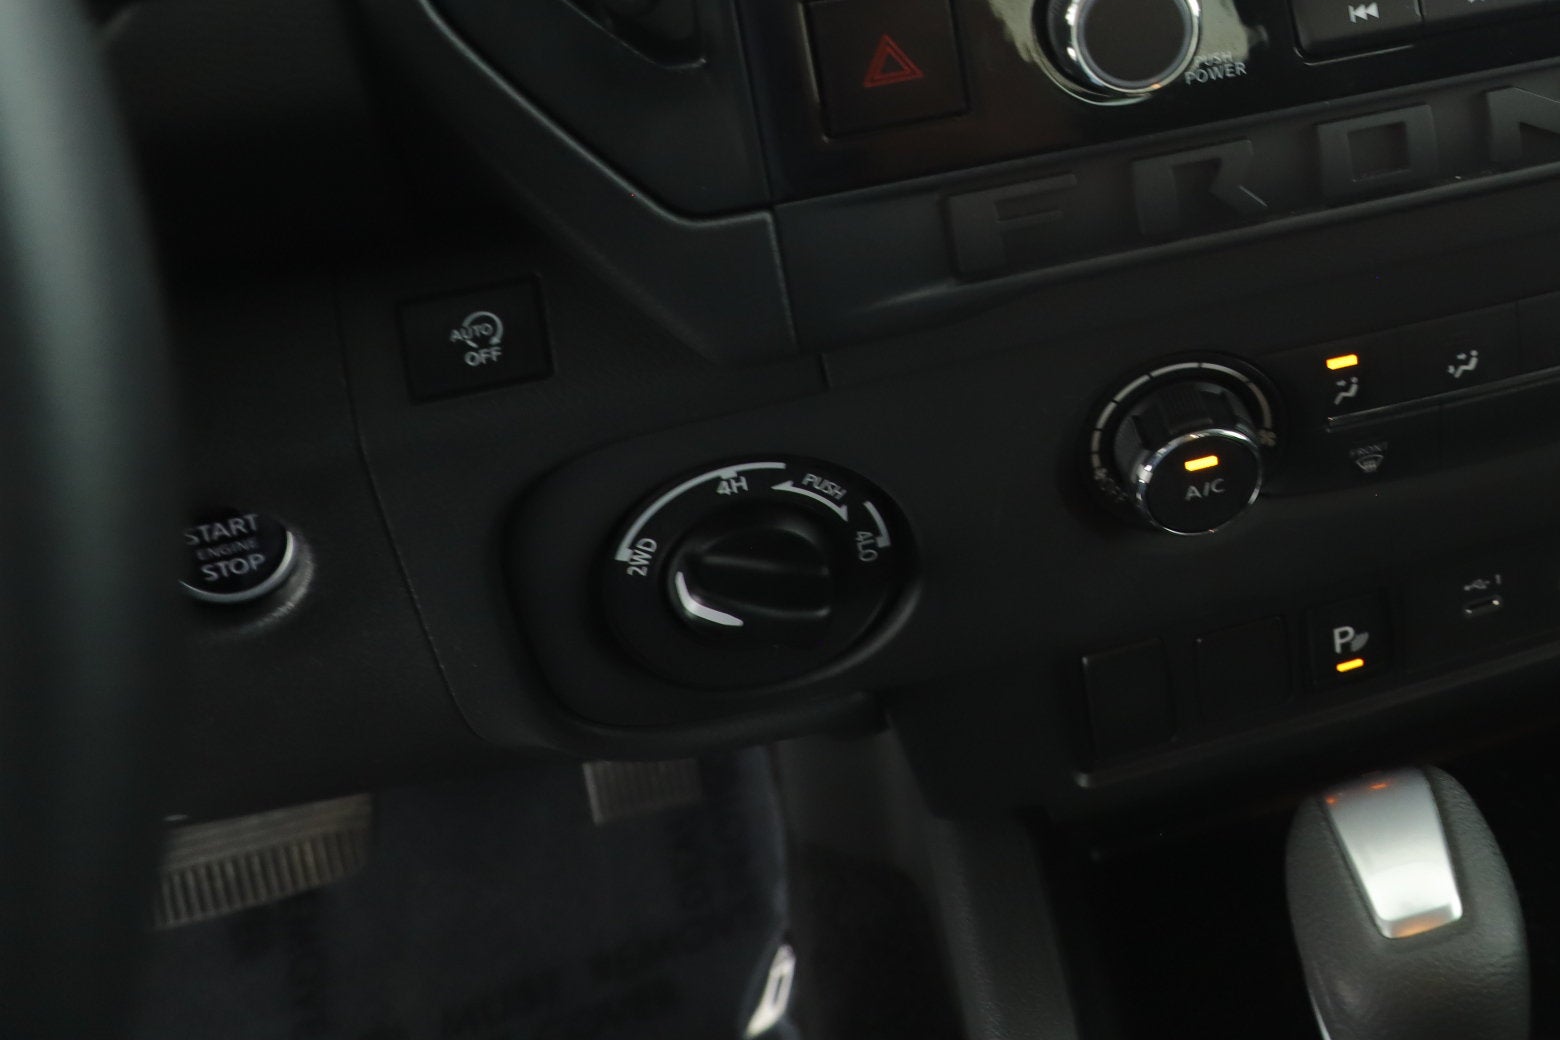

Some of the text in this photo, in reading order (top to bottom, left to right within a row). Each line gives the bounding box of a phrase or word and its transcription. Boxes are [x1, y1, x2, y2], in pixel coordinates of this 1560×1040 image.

[1183, 61, 1248, 86] POWER
[449, 322, 495, 343] AUTO
[464, 345, 503, 367] OFF
[715, 475, 748, 497] 4H
[801, 473, 848, 501] PUSH
[1184, 478, 1227, 501] A/C
[184, 513, 259, 545] START
[195, 536, 257, 560] ENGINE
[626, 538, 658, 577] 2WD
[855, 530, 879, 562] 4LO
[200, 553, 267, 581] STOP
